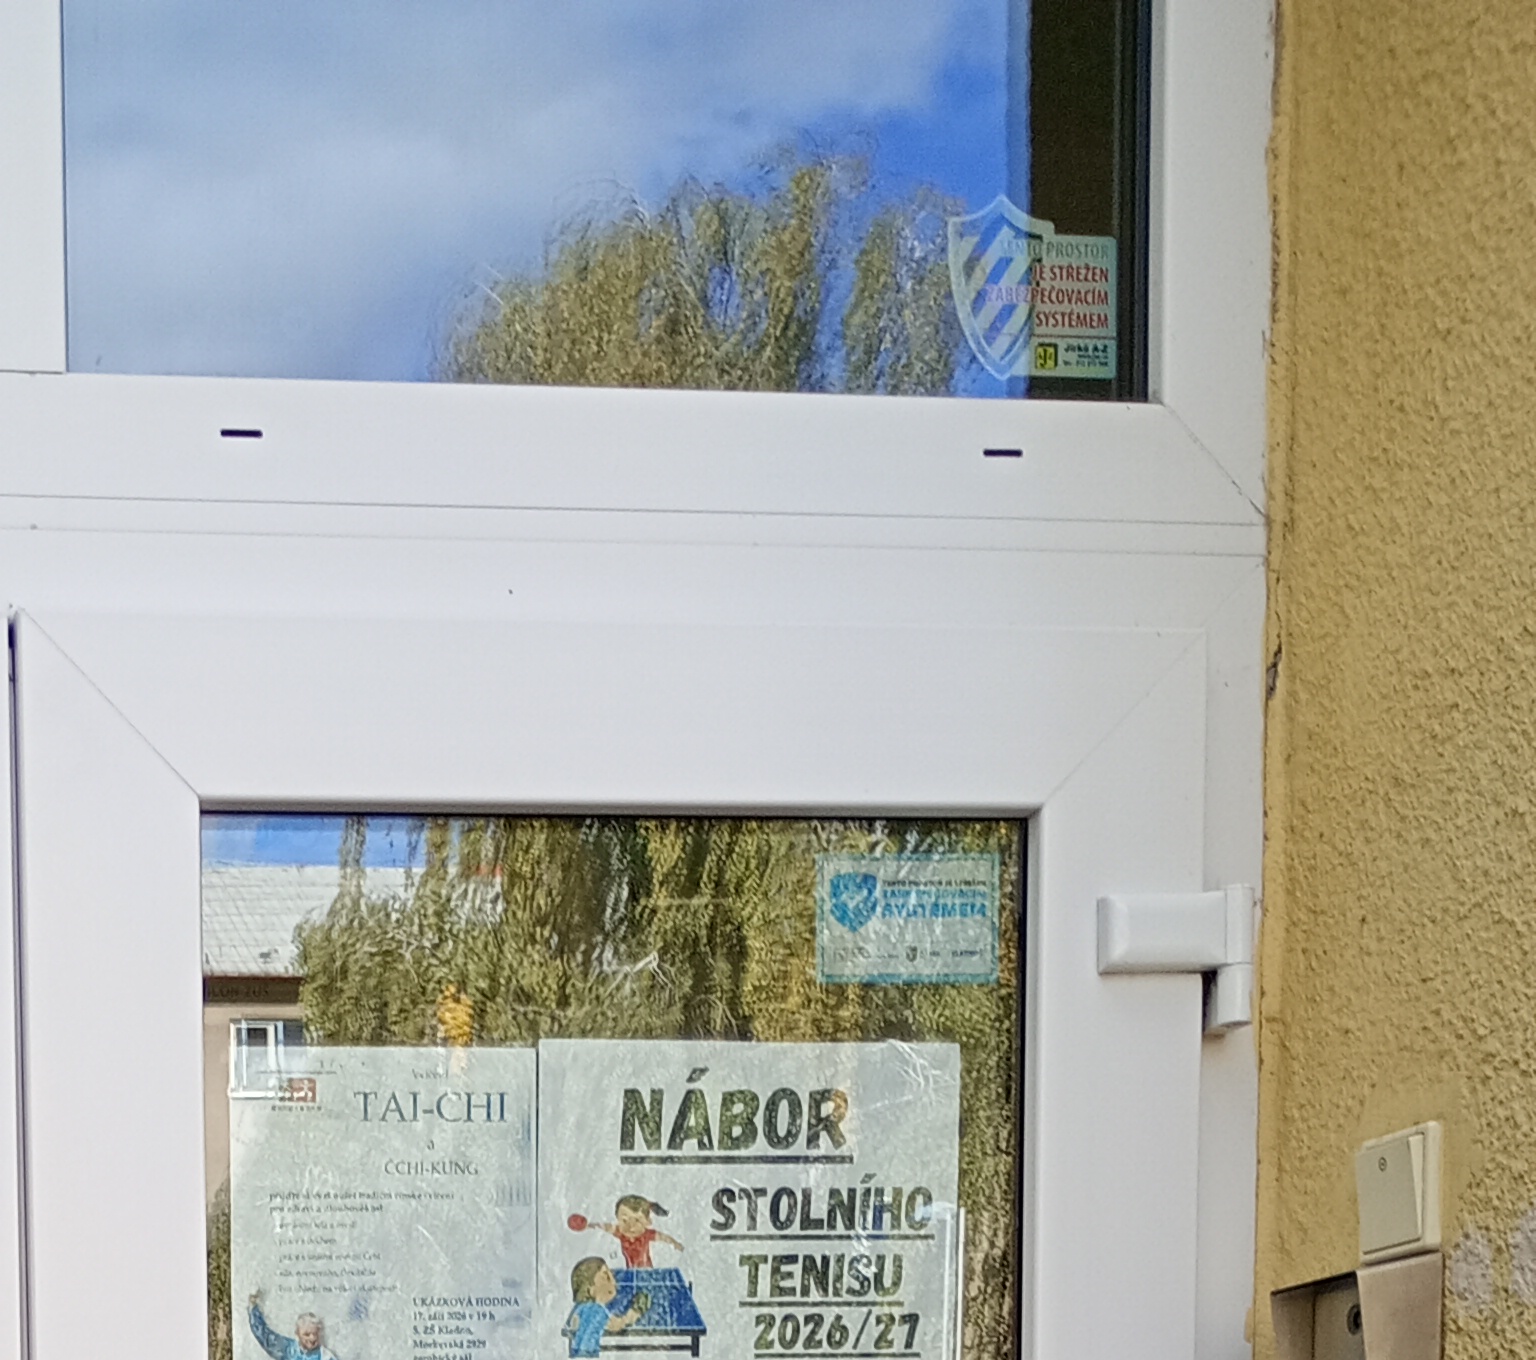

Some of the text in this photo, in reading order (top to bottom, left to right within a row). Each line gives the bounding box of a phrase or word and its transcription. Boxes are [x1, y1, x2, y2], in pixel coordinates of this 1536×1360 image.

[1046, 242, 1109, 259] PROSTOR
[1032, 262, 1109, 283] JE STŘEŽEN
[1035, 308, 1109, 329] SYSTÉMEM
[354, 1091, 508, 1122] TAI-CHI
[619, 1067, 849, 1151] NÁBOR
[384, 1158, 478, 1176] ČCHI-KUNG
[709, 1172, 933, 1232] STOLNÍHO
[739, 1254, 904, 1298] TENISU
[753, 1308, 921, 1351] 2026/27
